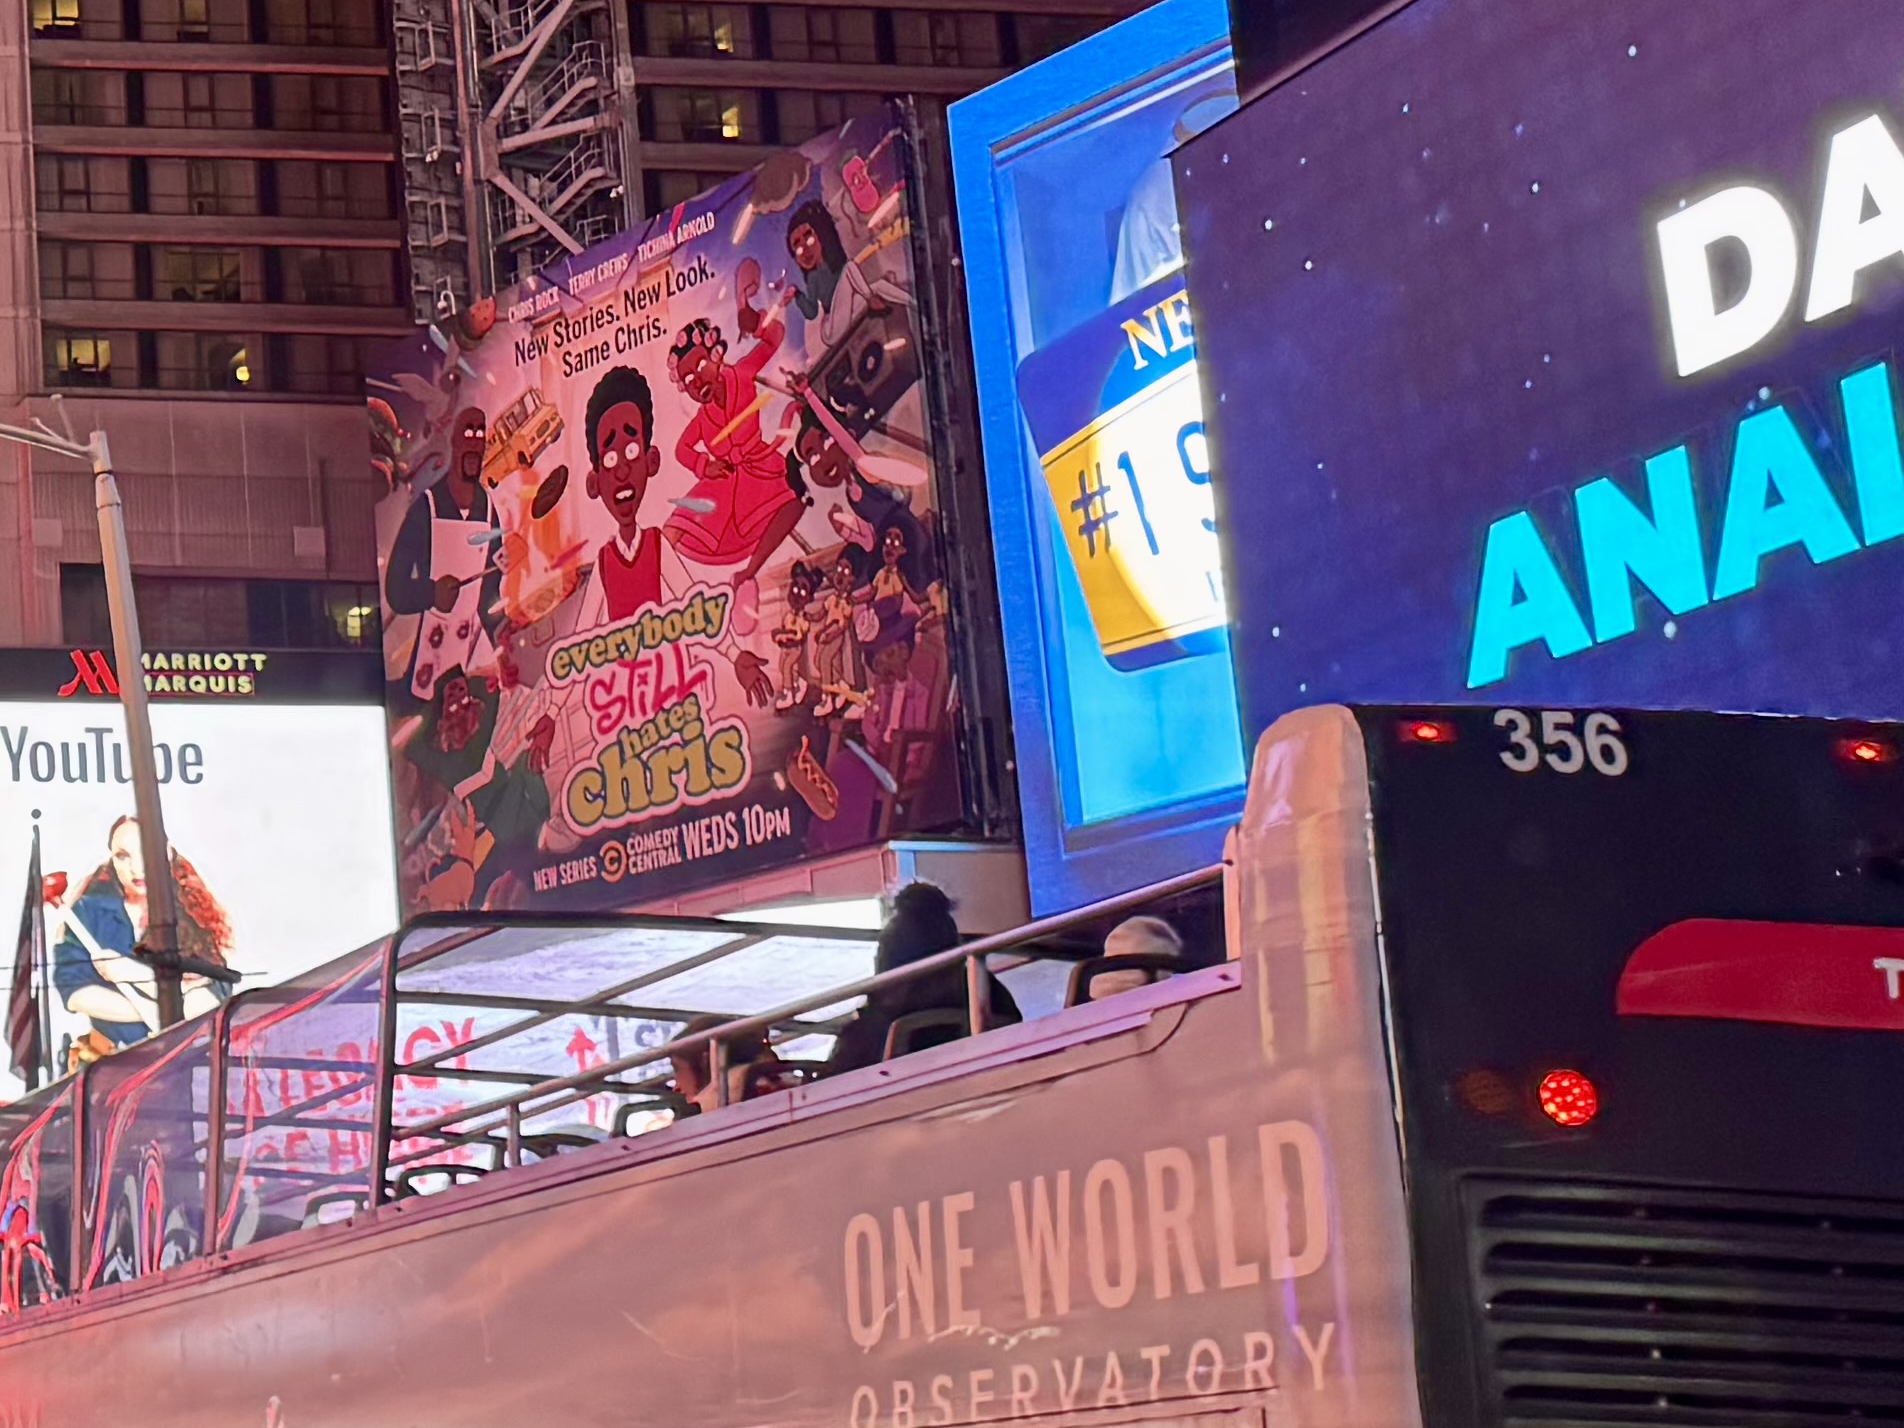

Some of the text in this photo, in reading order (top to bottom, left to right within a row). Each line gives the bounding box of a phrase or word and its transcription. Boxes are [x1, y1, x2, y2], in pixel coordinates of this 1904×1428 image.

[508, 211, 716, 323] CHRIS ROCK TERRY CREWS TICHINA ARNOLD
[514, 255, 716, 368] New Stories. New Look.
[562, 314, 667, 379] Same Chris.
[550, 590, 729, 680] everybody
[617, 691, 701, 760] hates
[1493, 706, 1630, 777] 356
[566, 720, 746, 827] chris
[625, 824, 680, 856] COMEDY
[627, 842, 683, 875] CENTRAL
[682, 803, 792, 861] WEDS 10PM
[532, 855, 598, 892] NEW SERIES
[842, 1118, 1330, 1351] ONE WORLD
